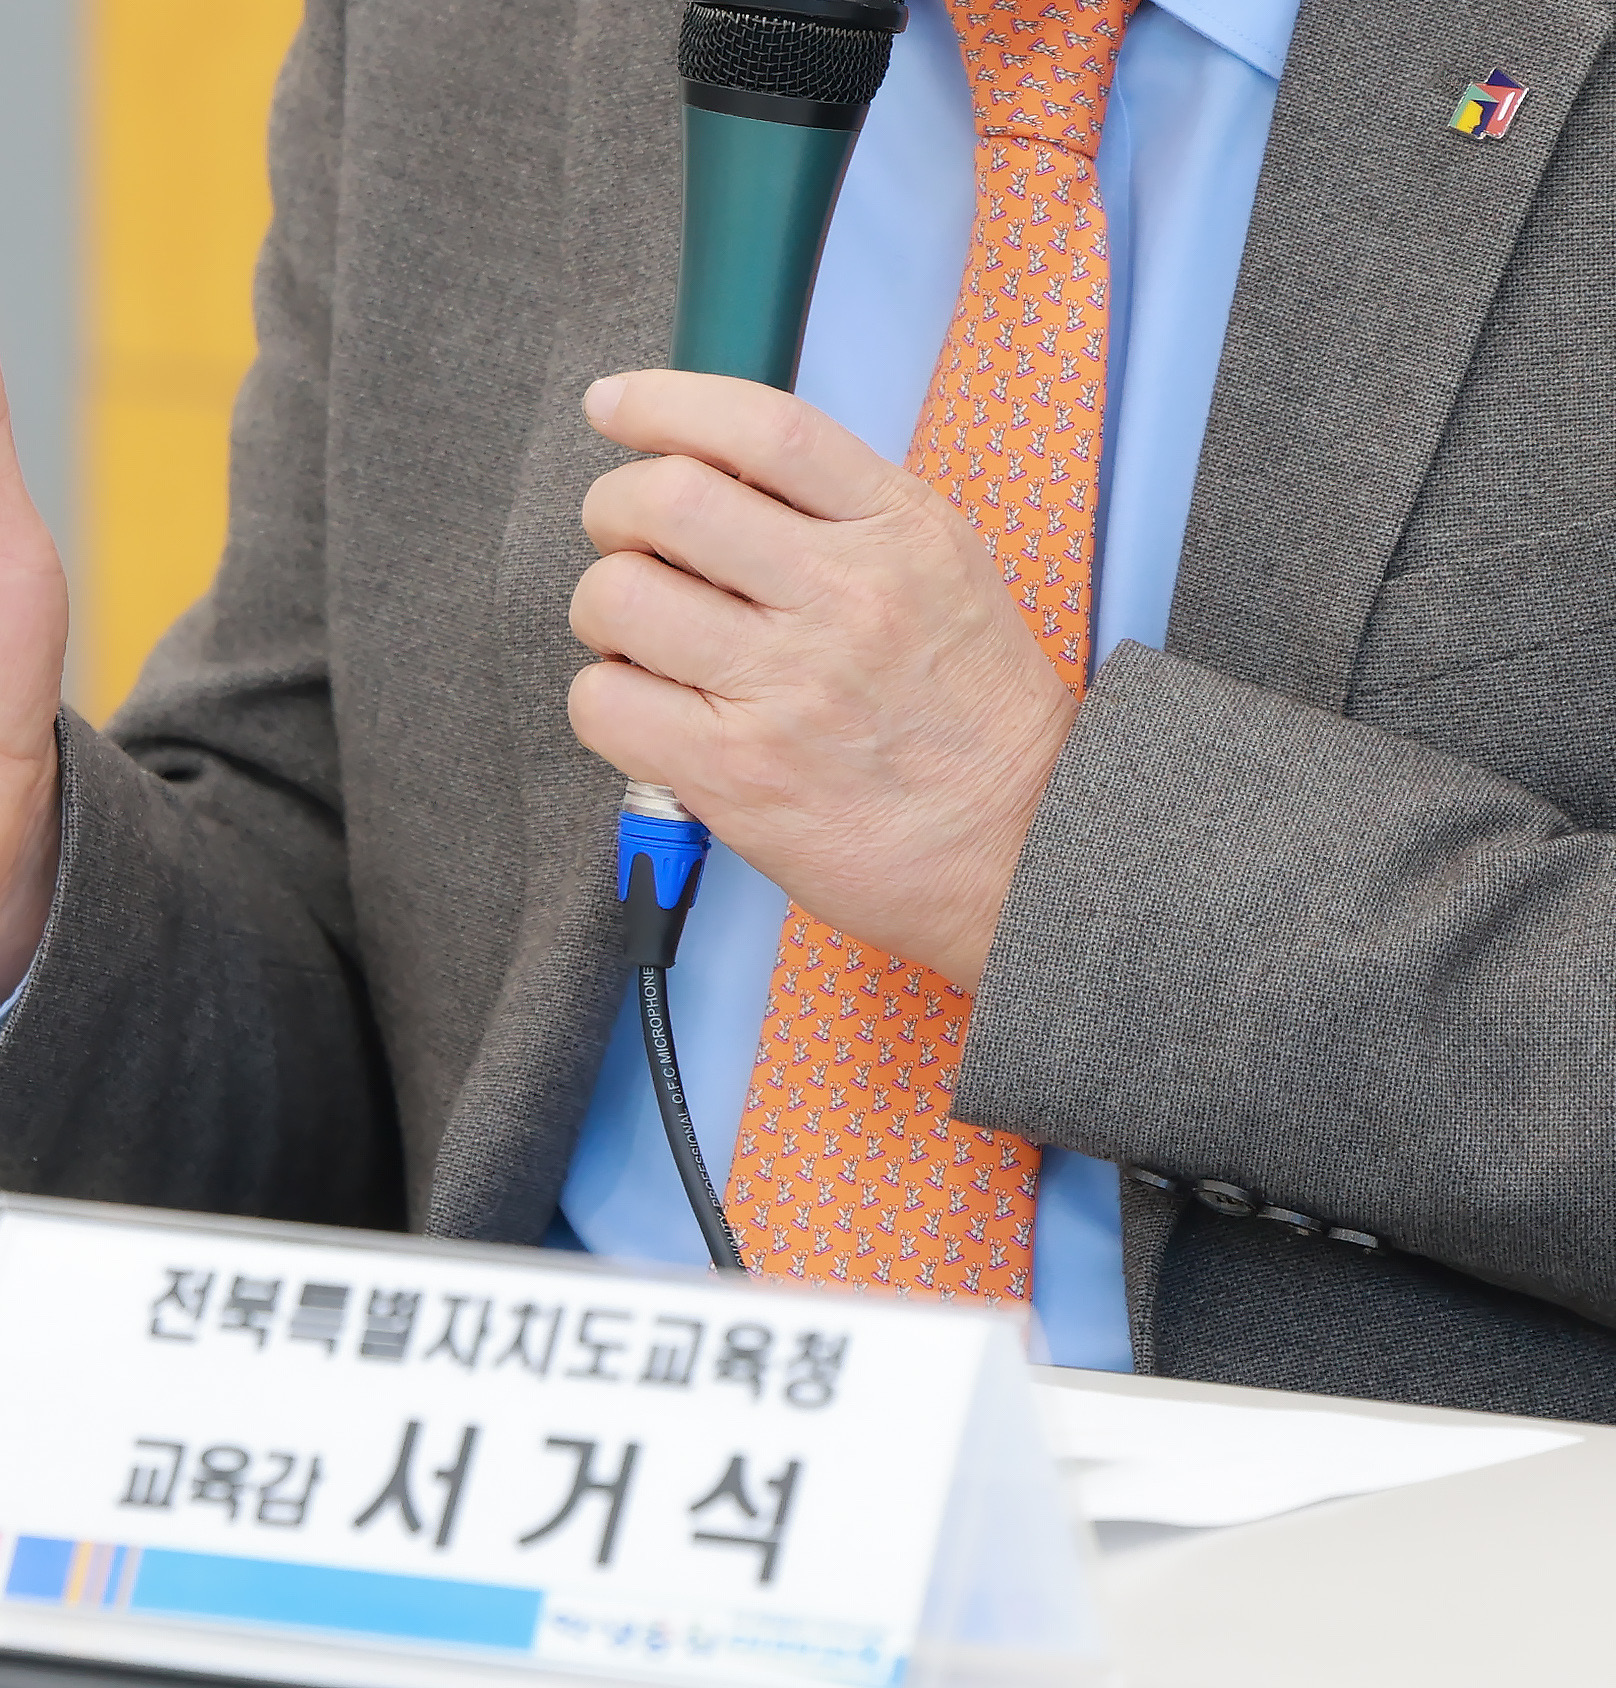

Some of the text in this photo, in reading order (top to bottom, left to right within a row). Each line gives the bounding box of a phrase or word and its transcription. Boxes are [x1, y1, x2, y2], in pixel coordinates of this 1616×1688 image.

[643, 965, 672, 1065] MICROPHONE
[148, 1265, 851, 1410] 전북특별자치도교육청
[118, 1436, 324, 1527] 교육감
